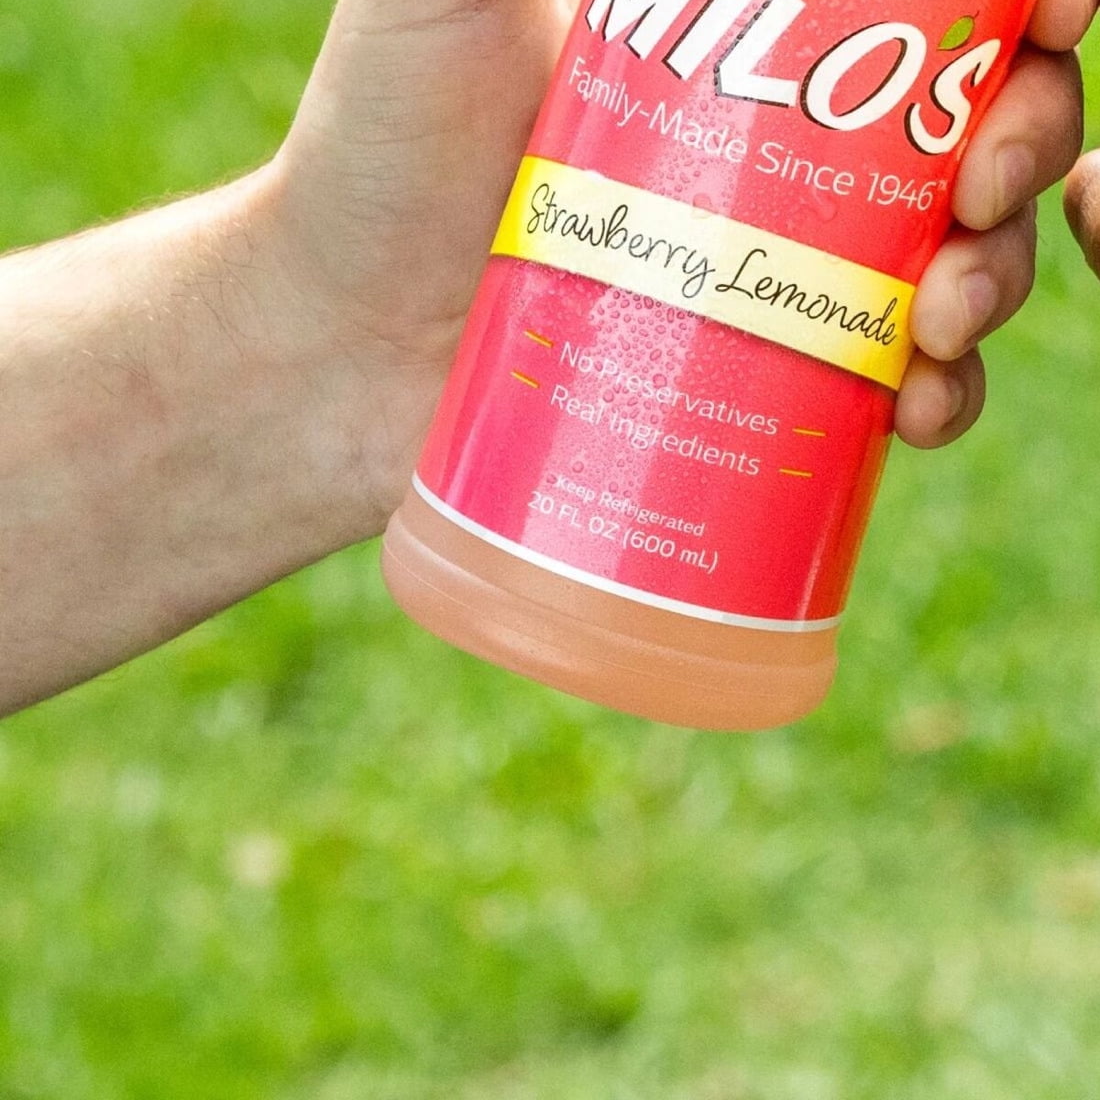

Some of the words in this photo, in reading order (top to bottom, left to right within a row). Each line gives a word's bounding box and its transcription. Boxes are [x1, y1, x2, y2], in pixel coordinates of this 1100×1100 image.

[567, 55, 748, 164] Family-Made
[755, 141, 855, 197] Since
[526, 182, 716, 299] Strawberry
[714, 248, 899, 347] Lemonade
[549, 383, 605, 426] Real
[609, 409, 762, 477] Ingredients
[559, 340, 594, 374] No
[597, 357, 781, 436] Preservatives
[527, 490, 555, 516] 20
[557, 503, 583, 529] FL
[587, 515, 621, 541] OZ
[622, 527, 677, 560] (600
[678, 549, 720, 576] mL)
[554, 474, 597, 503] Keep
[599, 490, 707, 538] Refrigerated
